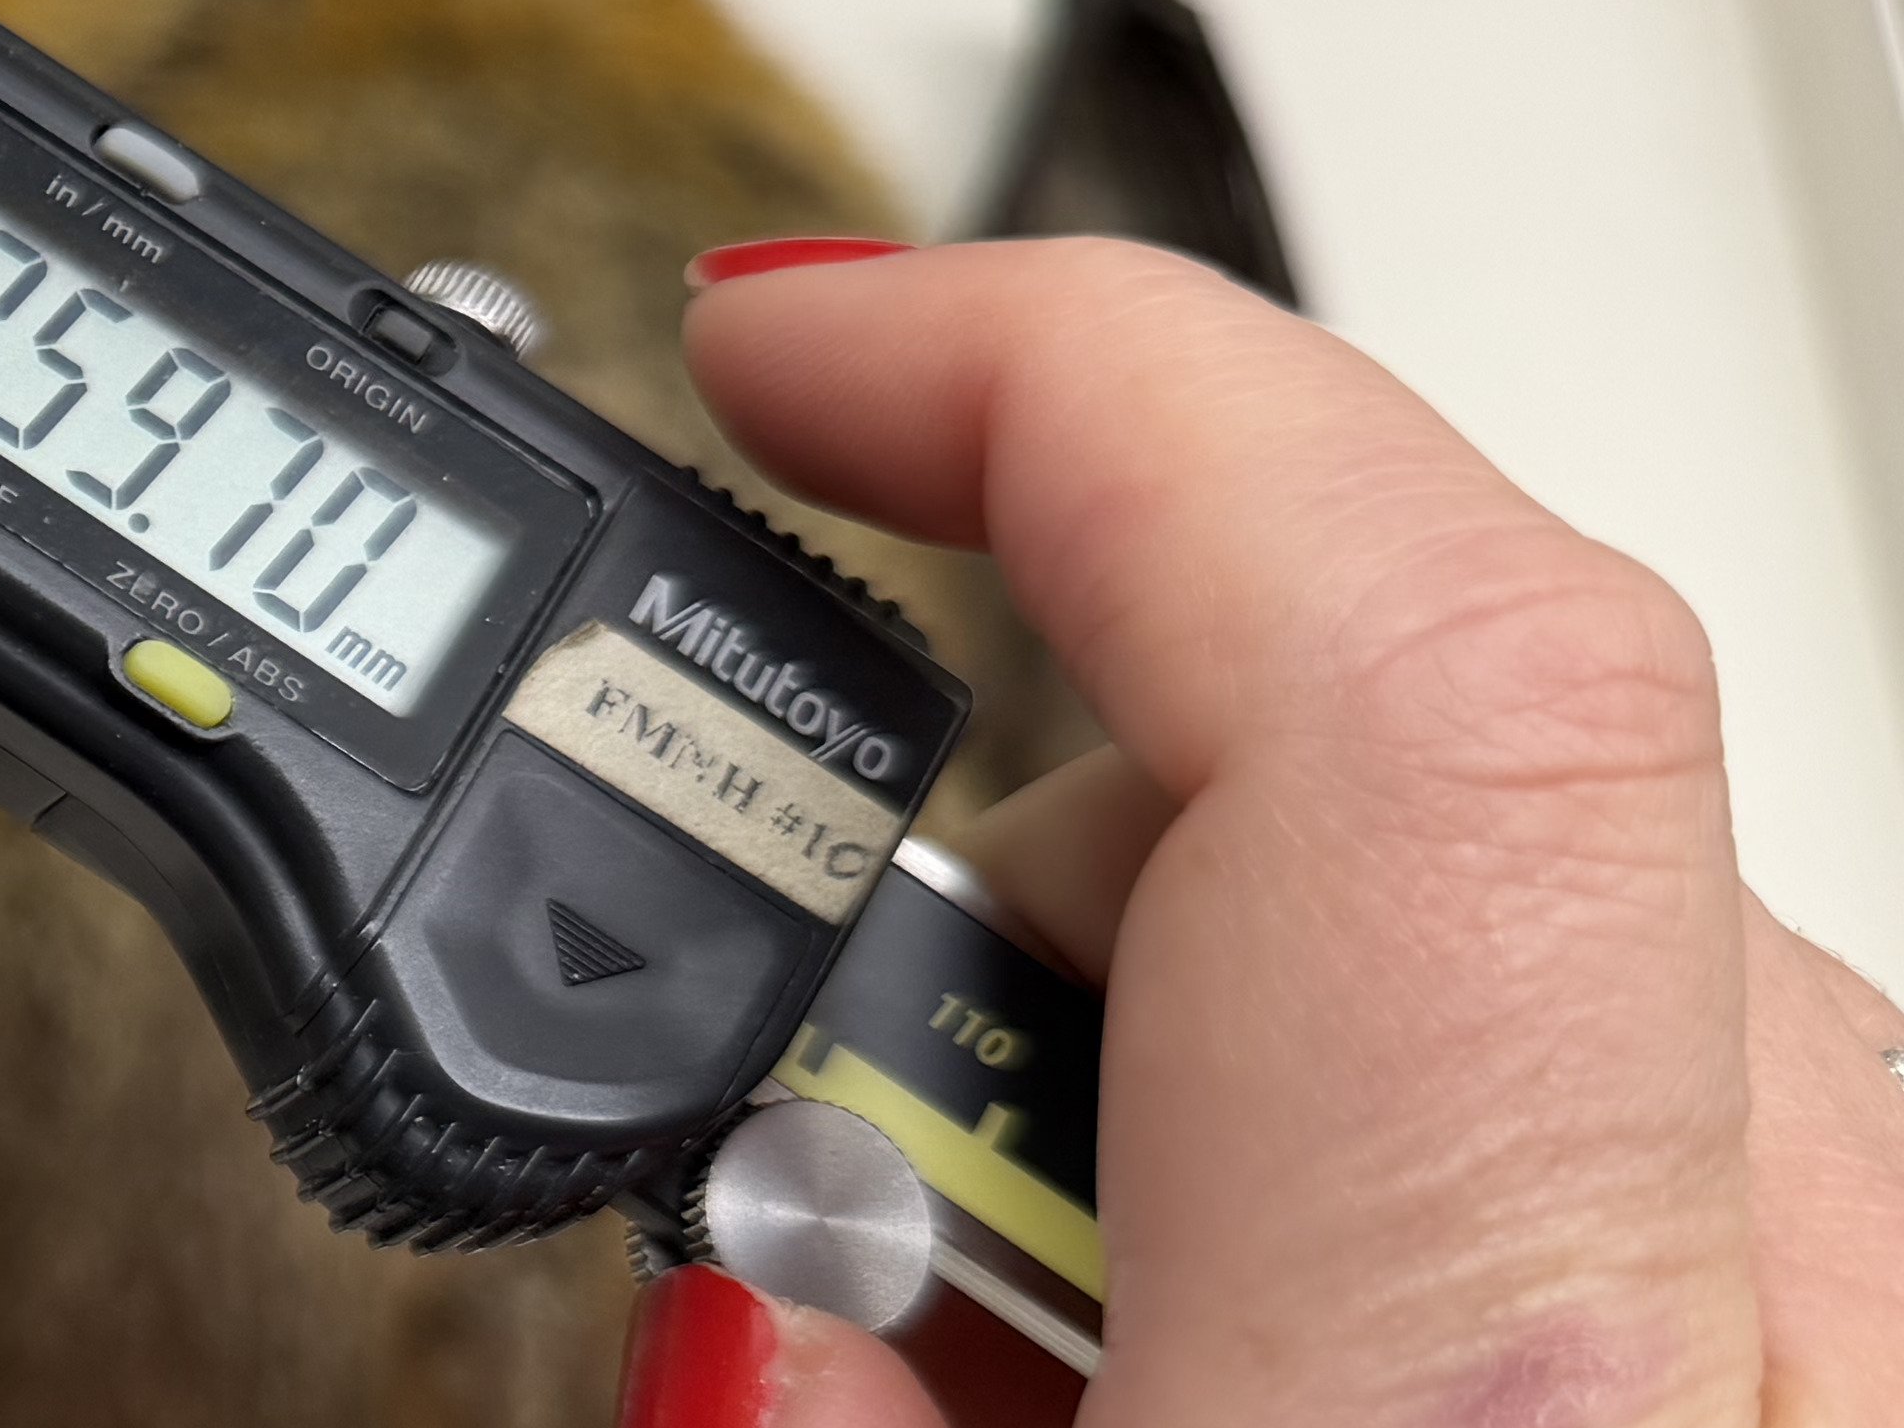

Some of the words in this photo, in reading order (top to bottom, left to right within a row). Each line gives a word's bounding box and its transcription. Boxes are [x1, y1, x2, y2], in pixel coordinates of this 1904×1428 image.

[305, 344, 428, 436] ORIGIN
[325, 625, 408, 693] mm
[628, 575, 894, 780] Mitutoyo
[928, 992, 1011, 1065] 110
